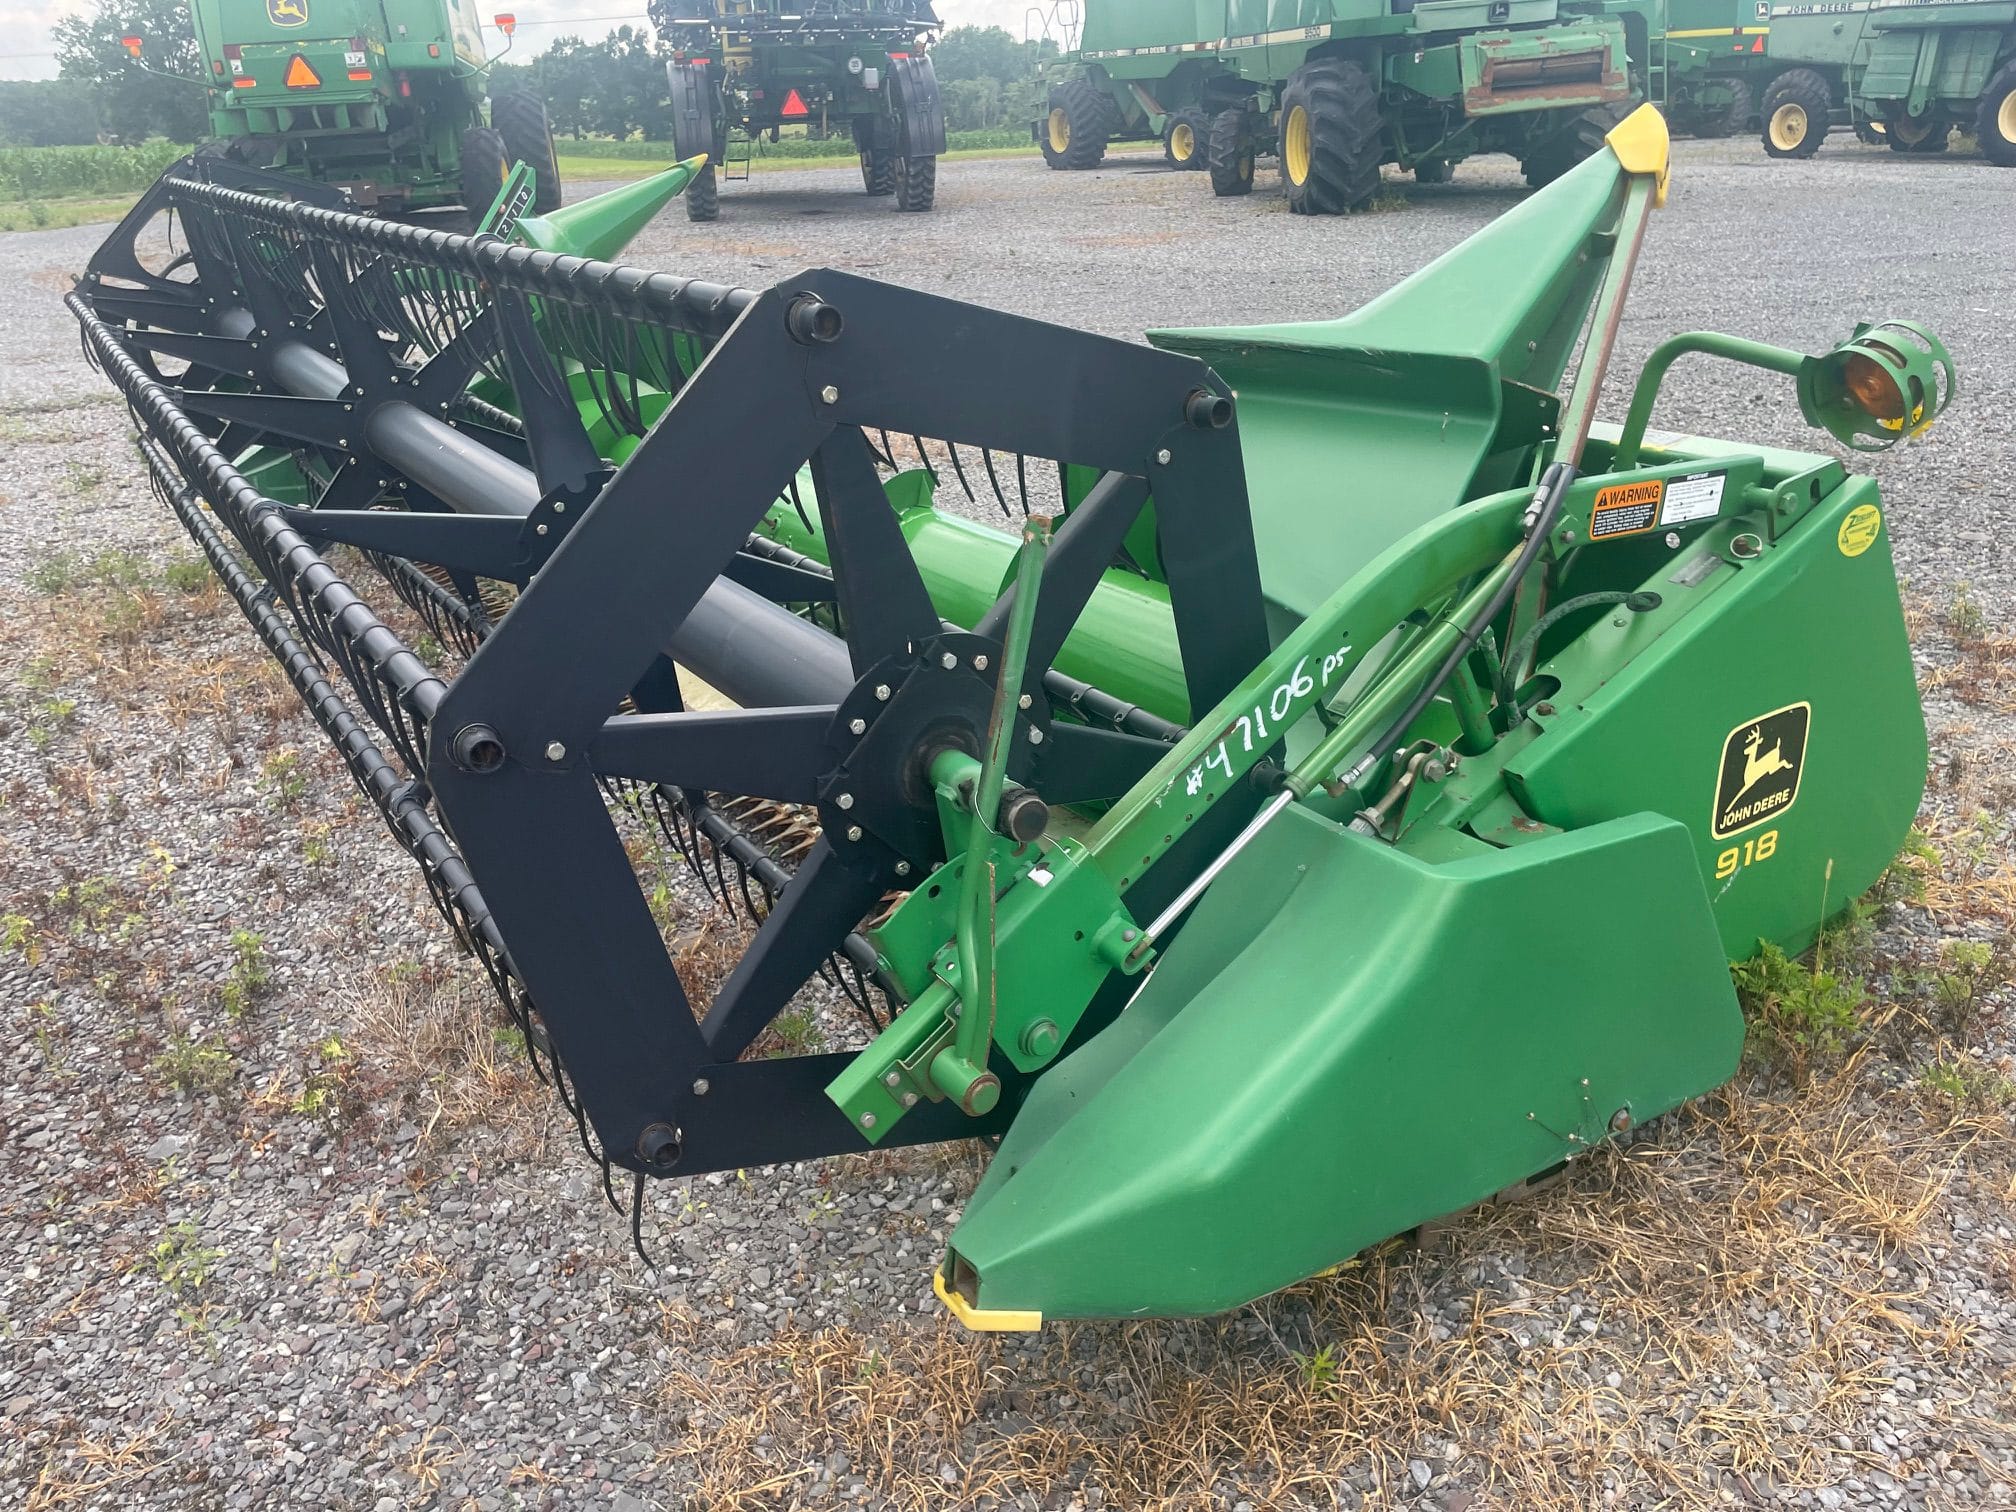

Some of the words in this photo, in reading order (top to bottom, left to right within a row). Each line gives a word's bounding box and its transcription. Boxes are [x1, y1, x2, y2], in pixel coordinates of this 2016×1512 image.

[1788, 5, 1814, 14] JOHN
[1820, 3, 1854, 12] DEERE
[1609, 485, 1660, 506] WARNING
[1719, 804, 1752, 830] JOHN
[1752, 788, 1791, 816] DEERE
[1715, 830, 1778, 879] 918
